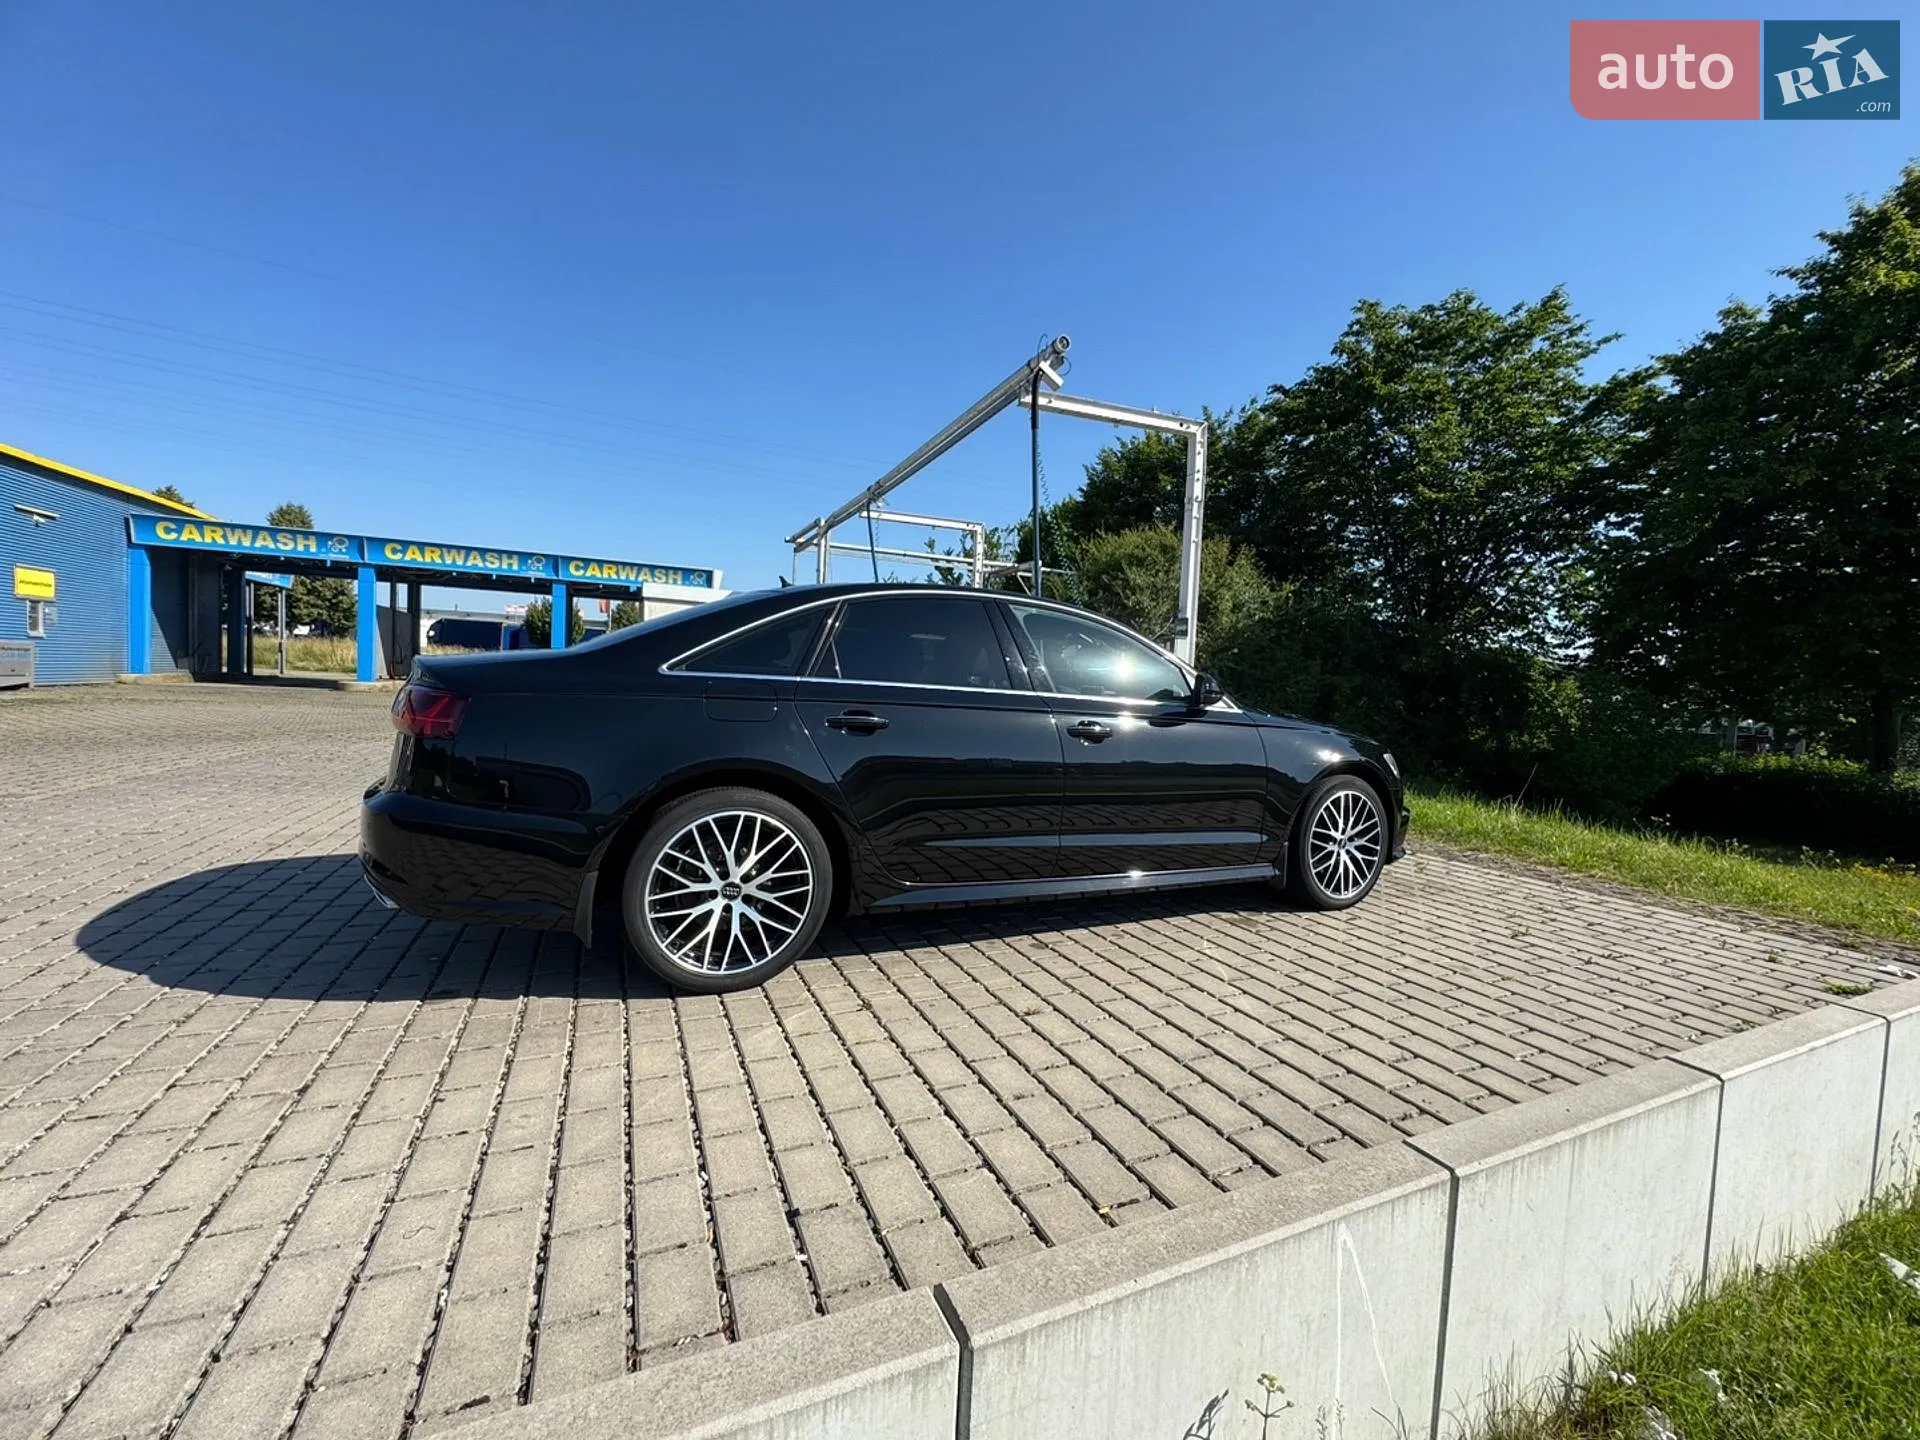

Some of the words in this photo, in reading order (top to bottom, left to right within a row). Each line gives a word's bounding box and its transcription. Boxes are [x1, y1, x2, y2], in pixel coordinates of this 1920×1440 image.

[155, 521, 317, 553] CARWASH
[384, 543, 519, 570] CARWASH
[568, 560, 683, 585] CARWASH
